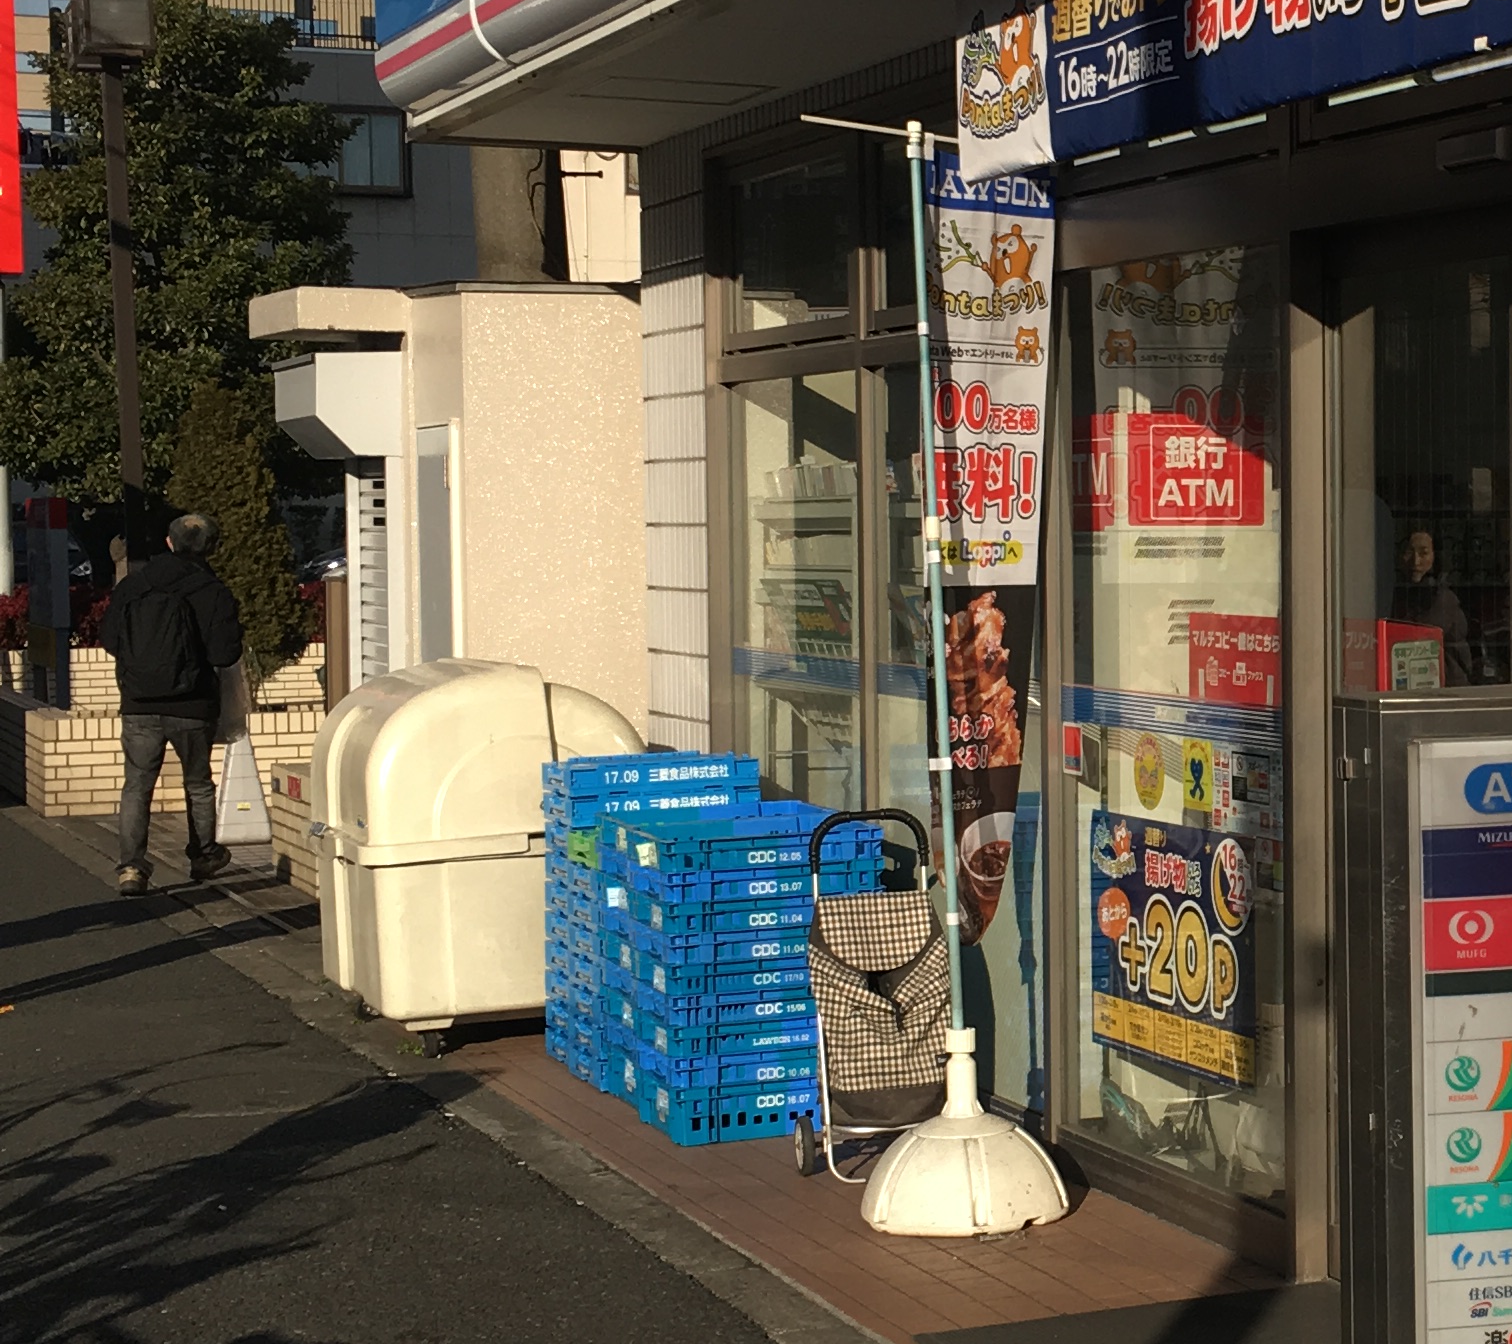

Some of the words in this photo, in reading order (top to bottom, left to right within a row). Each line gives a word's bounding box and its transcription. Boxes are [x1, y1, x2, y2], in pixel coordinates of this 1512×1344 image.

[926, 270, 1048, 317] ontaまつり!
[1165, 435, 1228, 470] 銀行
[1158, 478, 1235, 508] ATM
[604, 770, 639, 785] 17.09
[649, 764, 729, 782] 三菱食品株式会社
[748, 850, 776, 864] CDC
[749, 881, 777, 895] CDC
[749, 913, 778, 926] CDC
[780, 914, 803, 923] 11.04
[1102, 903, 1128, 922] あとから
[752, 943, 780, 957] CDC
[783, 944, 805, 954] 11.04
[1456, 949, 1487, 959] MUFG
[753, 972, 781, 985] CDC
[755, 1002, 783, 1015] CDC
[757, 1066, 785, 1080] CDC
[757, 1094, 785, 1108] CDC
[1448, 1094, 1478, 1102] RESONA
[1450, 1165, 1479, 1174] RESONA
[1470, 1307, 1489, 1319] SBI
